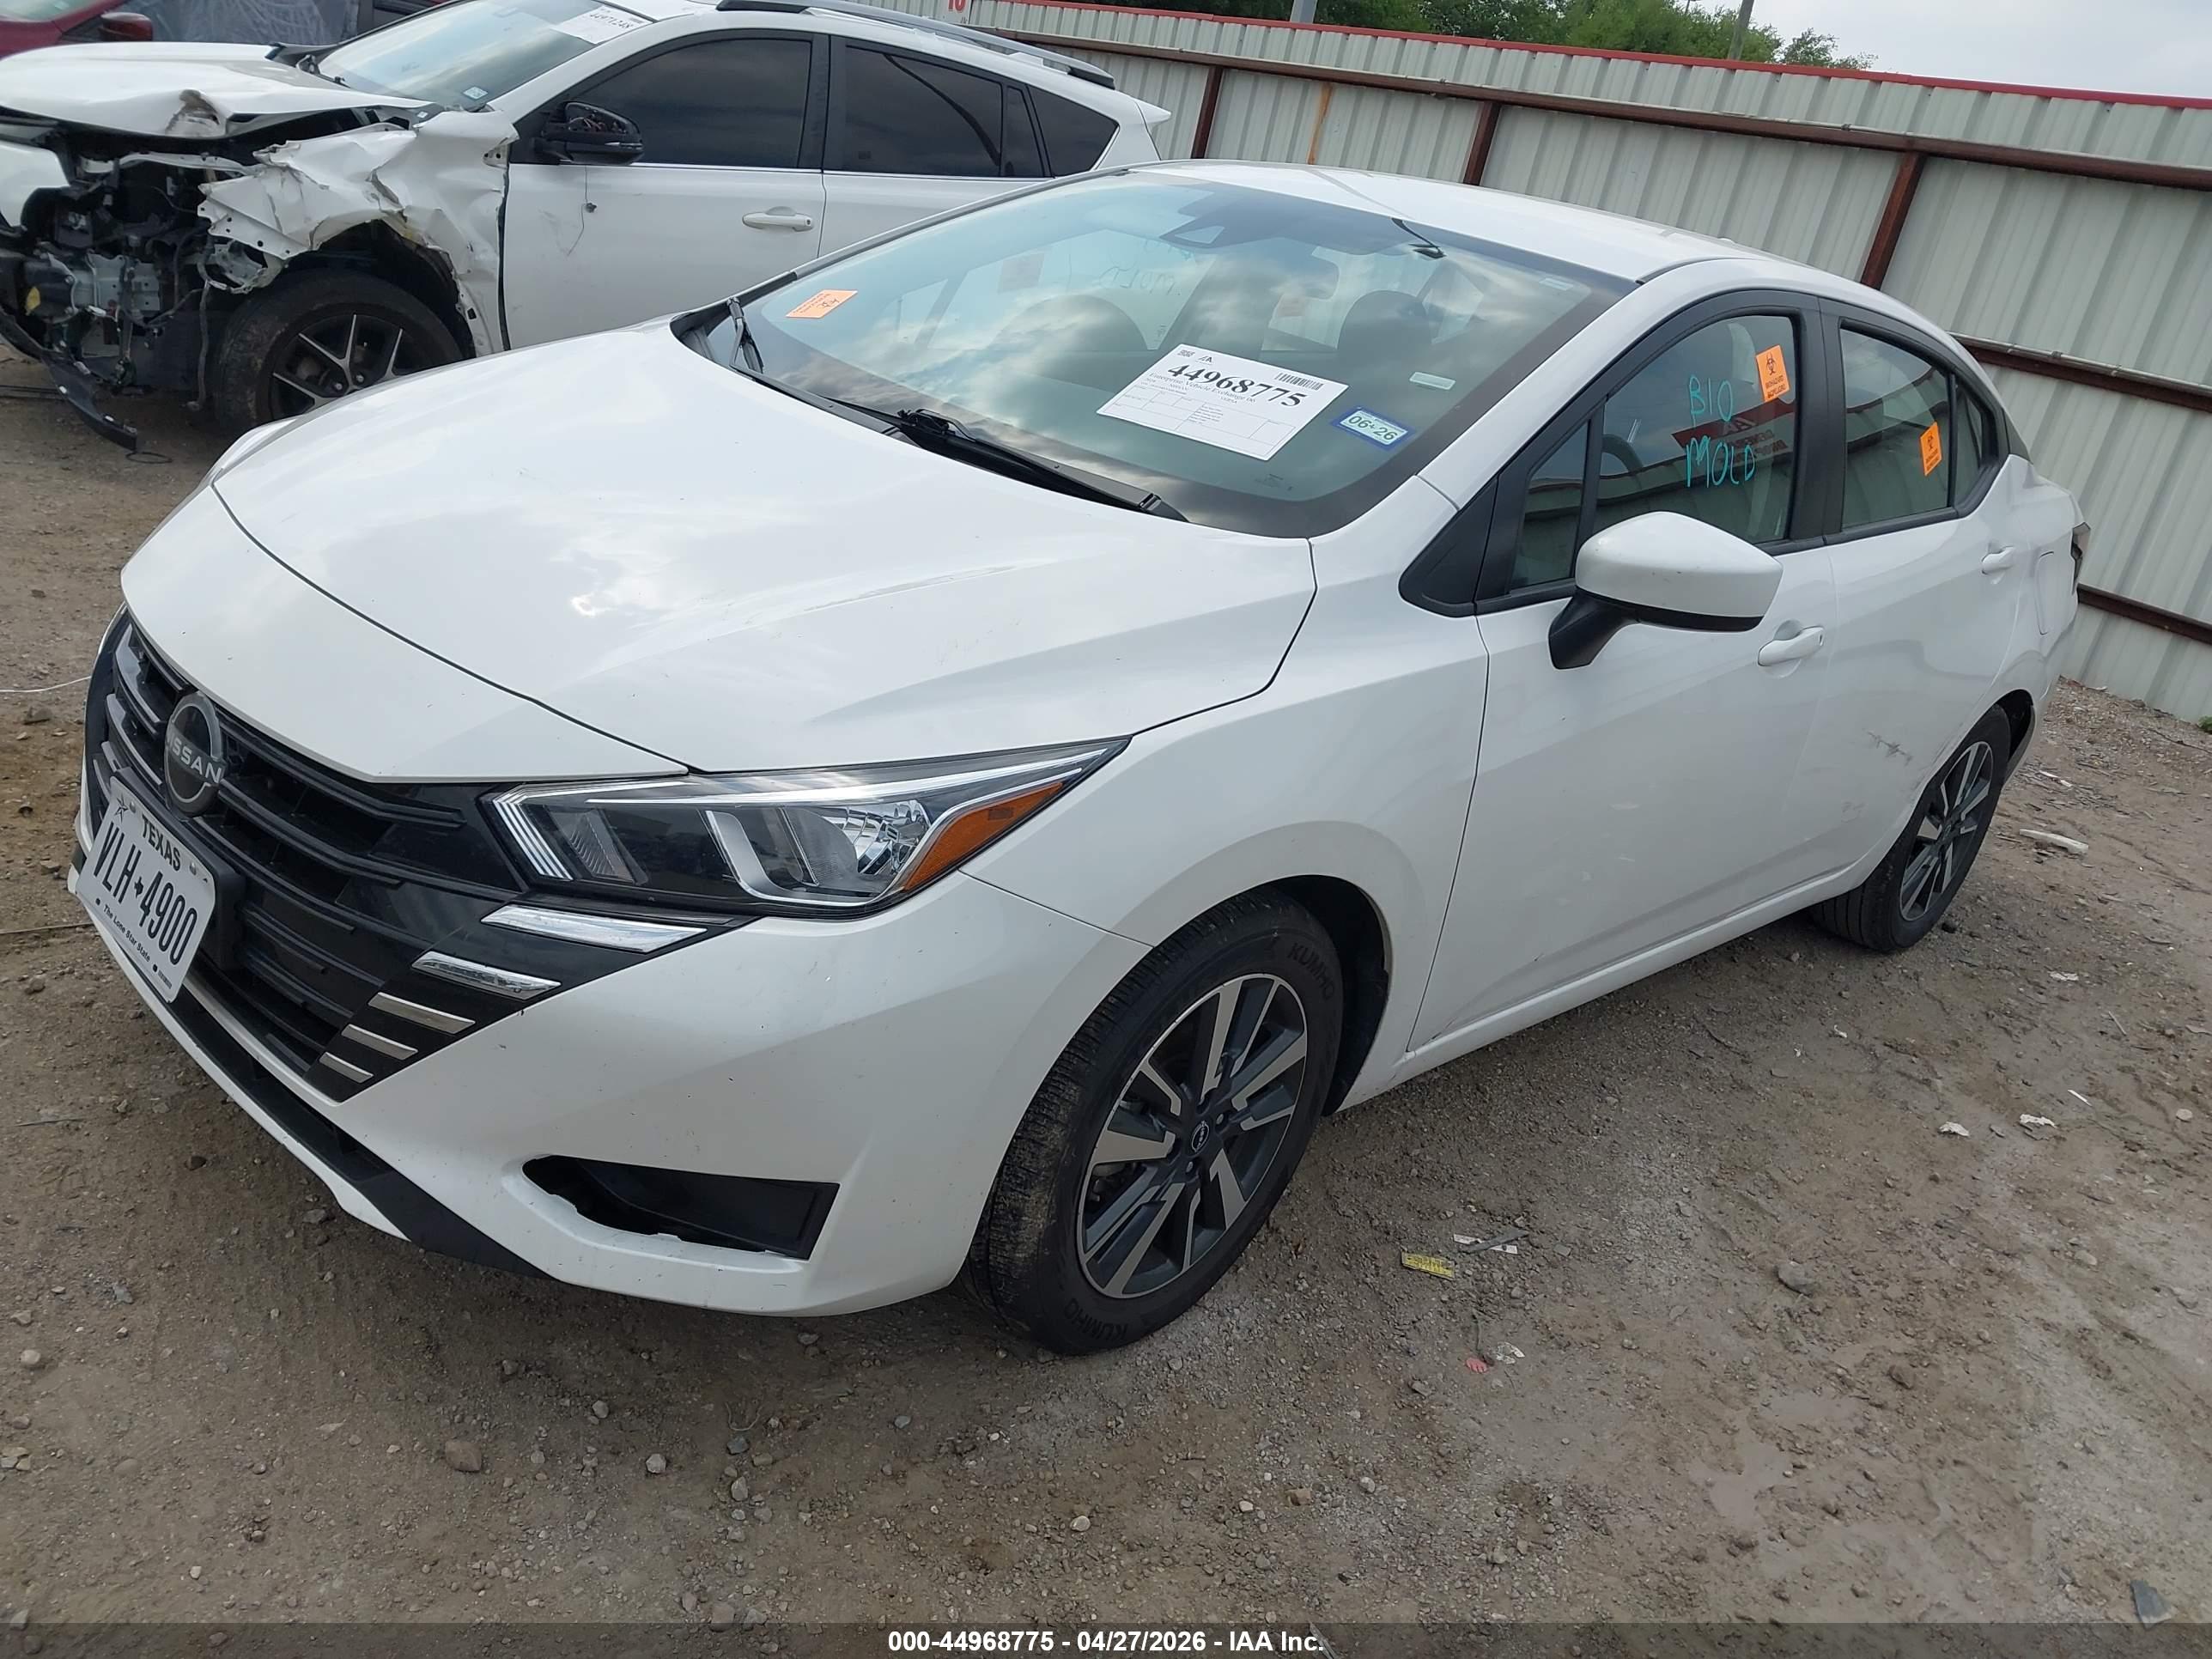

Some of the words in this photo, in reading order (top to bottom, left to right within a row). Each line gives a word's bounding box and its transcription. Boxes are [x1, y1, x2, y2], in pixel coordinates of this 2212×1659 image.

[1167, 364, 1310, 408] 44968775
[1689, 374, 1734, 428] BIO
[1686, 434, 1756, 489] MOLD
[167, 729, 223, 784] ISSAN
[141, 815, 181, 872] TEXAS
[103, 904, 113, 919] The
[113, 915, 126, 933] Lone
[126, 930, 137, 946] Star
[137, 943, 150, 963] State
[1287, 942, 1335, 1001] KUMHO
